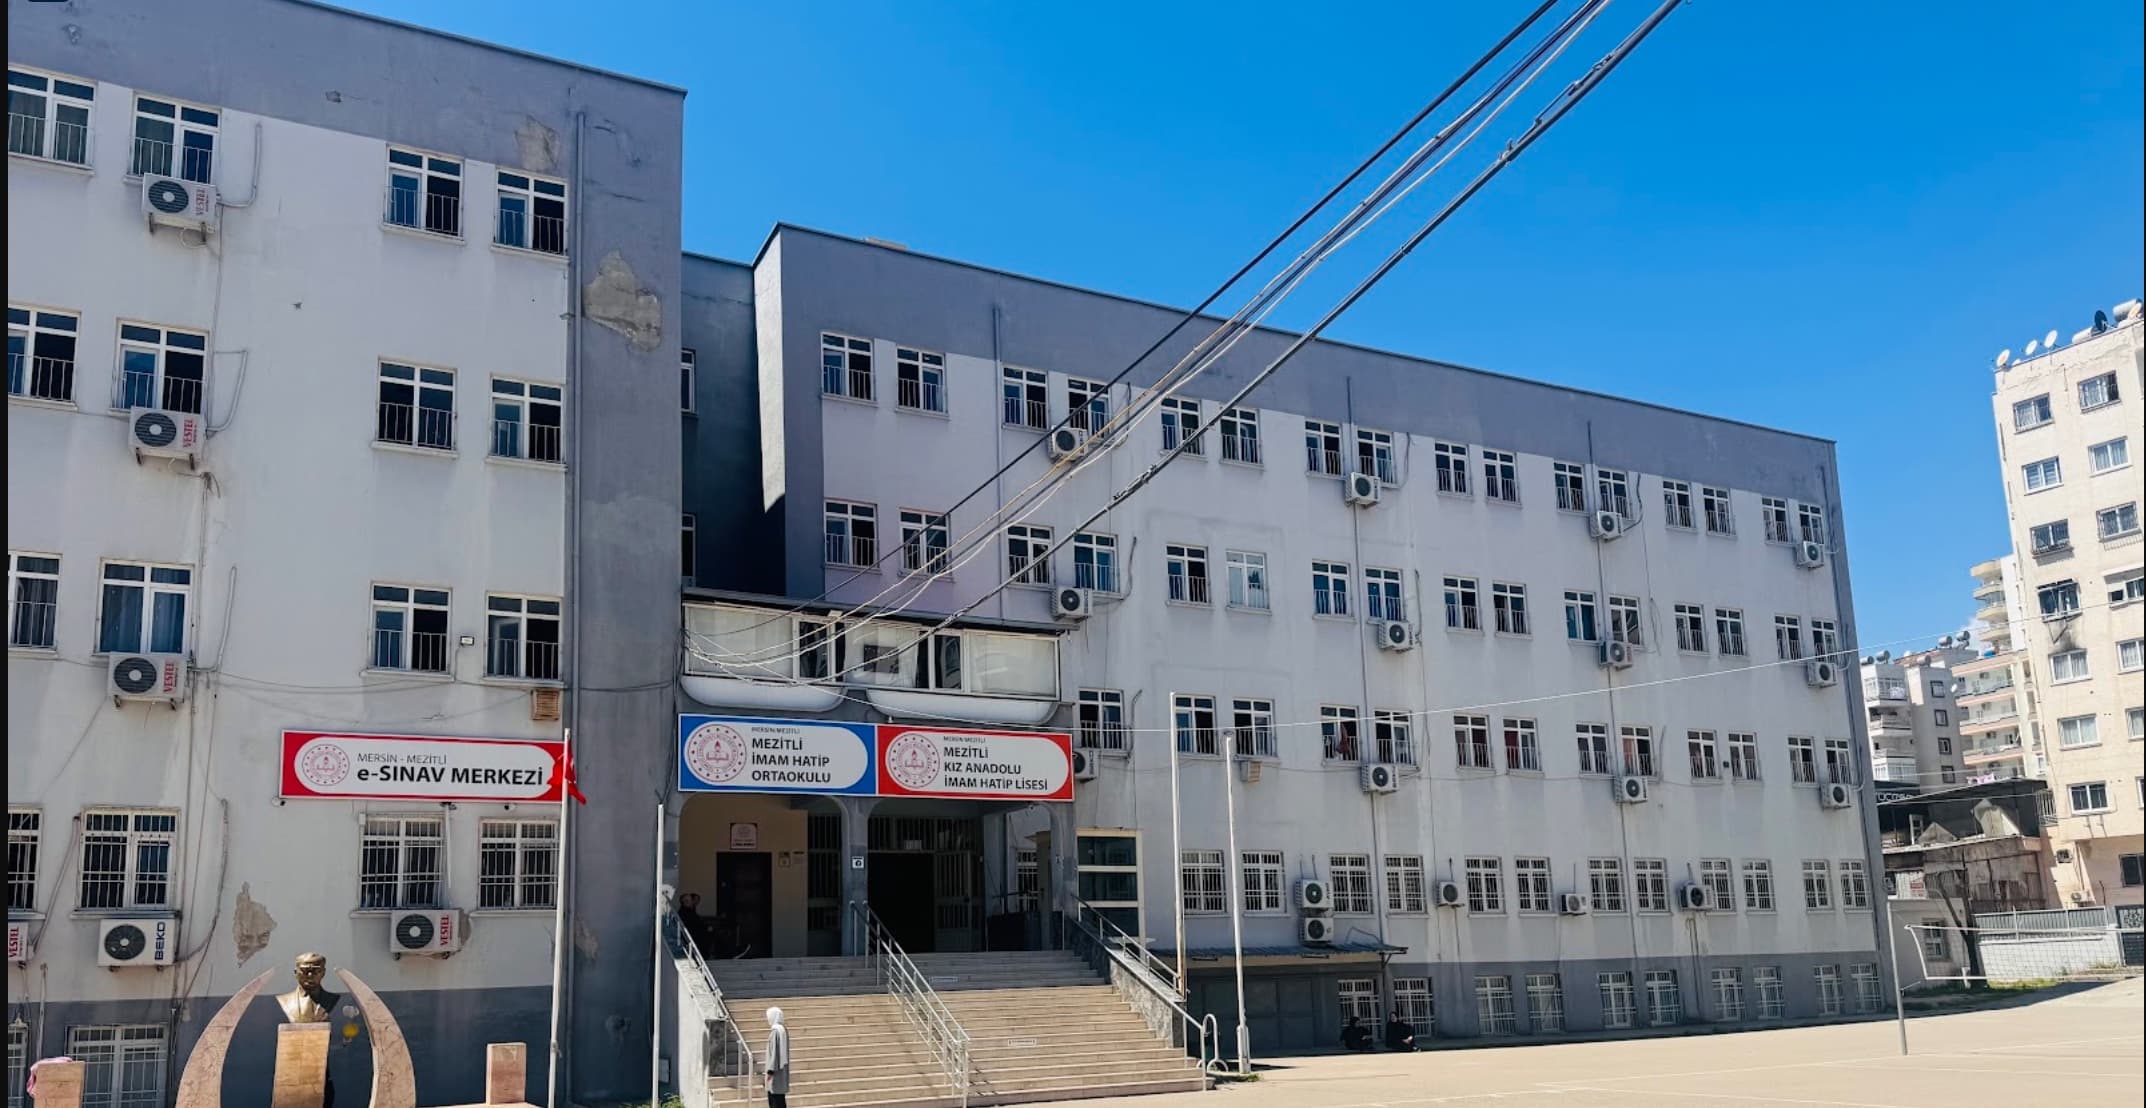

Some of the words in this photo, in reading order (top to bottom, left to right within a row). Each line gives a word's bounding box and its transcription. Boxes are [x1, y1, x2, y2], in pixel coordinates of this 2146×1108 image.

[183, 418, 193, 448] VESTEL
[163, 662, 174, 692] VESTEL
[752, 737, 802, 751] MEZİTLİ
[943, 746, 988, 759] MEZİTLİ
[357, 753, 398, 763] MERSİN
[406, 753, 447, 764] MEZİTLİ
[752, 753, 789, 766] İMAM
[792, 755, 830, 768] HATİP
[357, 765, 445, 782] e-SINAV
[451, 766, 543, 785] MERKEZİ
[752, 770, 831, 783] ORTAOKULU
[944, 762, 962, 773] KIZ
[965, 763, 1021, 775] ANADOLU
[944, 774, 977, 788] İMAM
[980, 777, 1013, 790] HATİP
[1015, 777, 1048, 791] LİSESİ
[440, 915, 450, 946] VESTEL
[9, 926, 20, 958] VESTEL
[155, 921, 166, 960] BEKO
